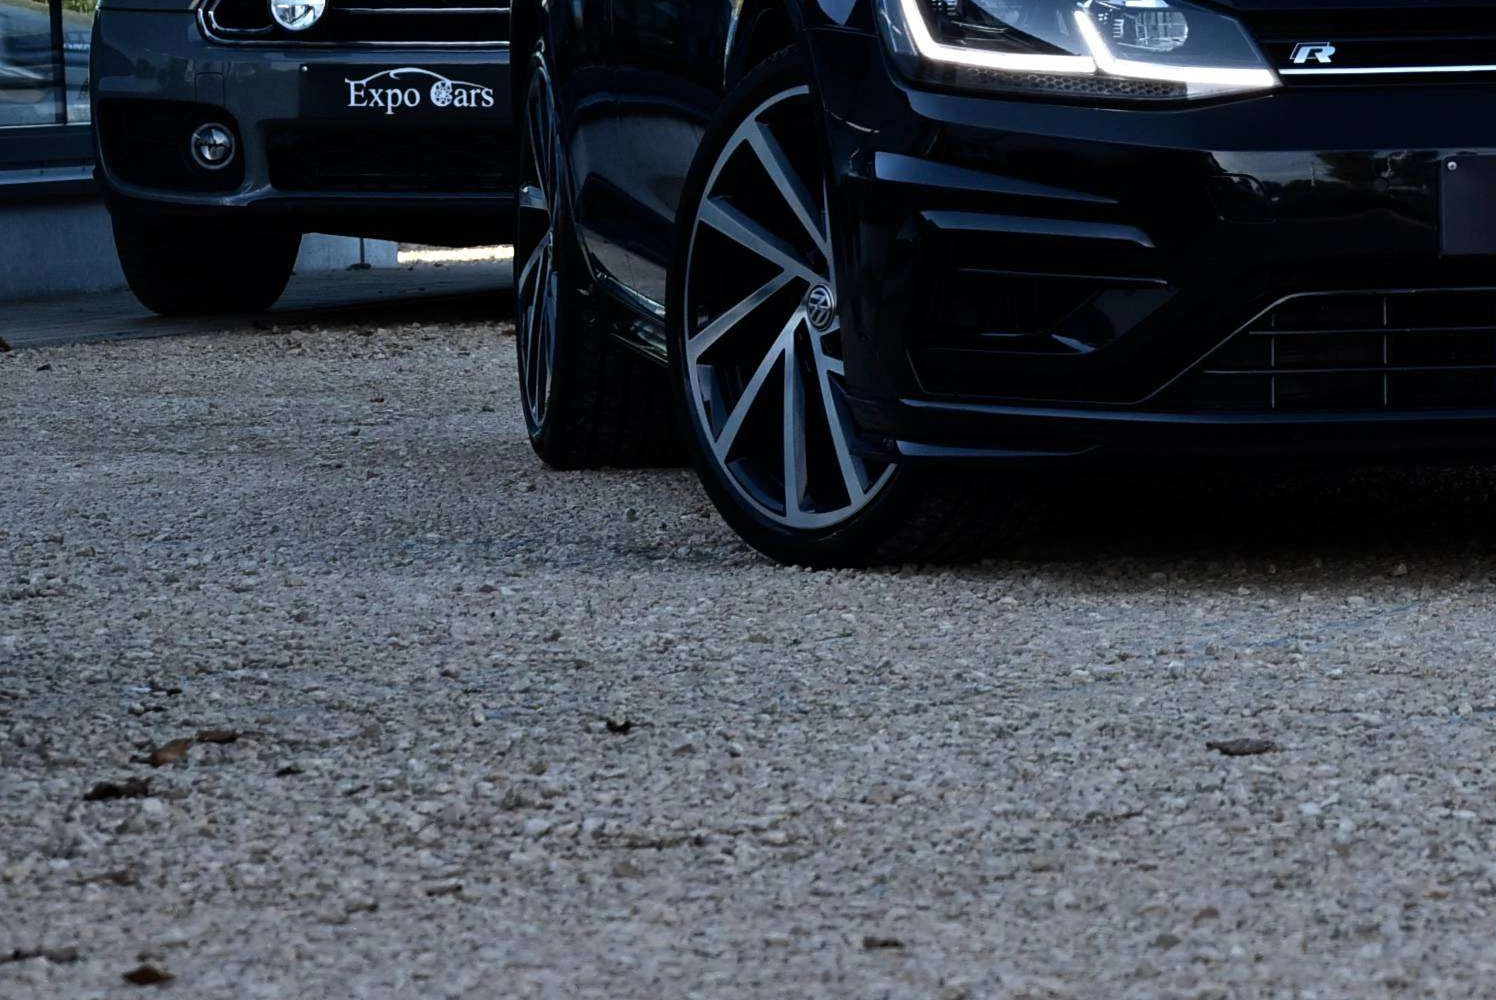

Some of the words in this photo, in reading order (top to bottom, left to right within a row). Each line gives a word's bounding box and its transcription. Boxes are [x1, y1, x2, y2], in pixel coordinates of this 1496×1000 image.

[1292, 44, 1336, 64] R
[346, 80, 421, 115] Expo
[430, 80, 495, 107] Cars
